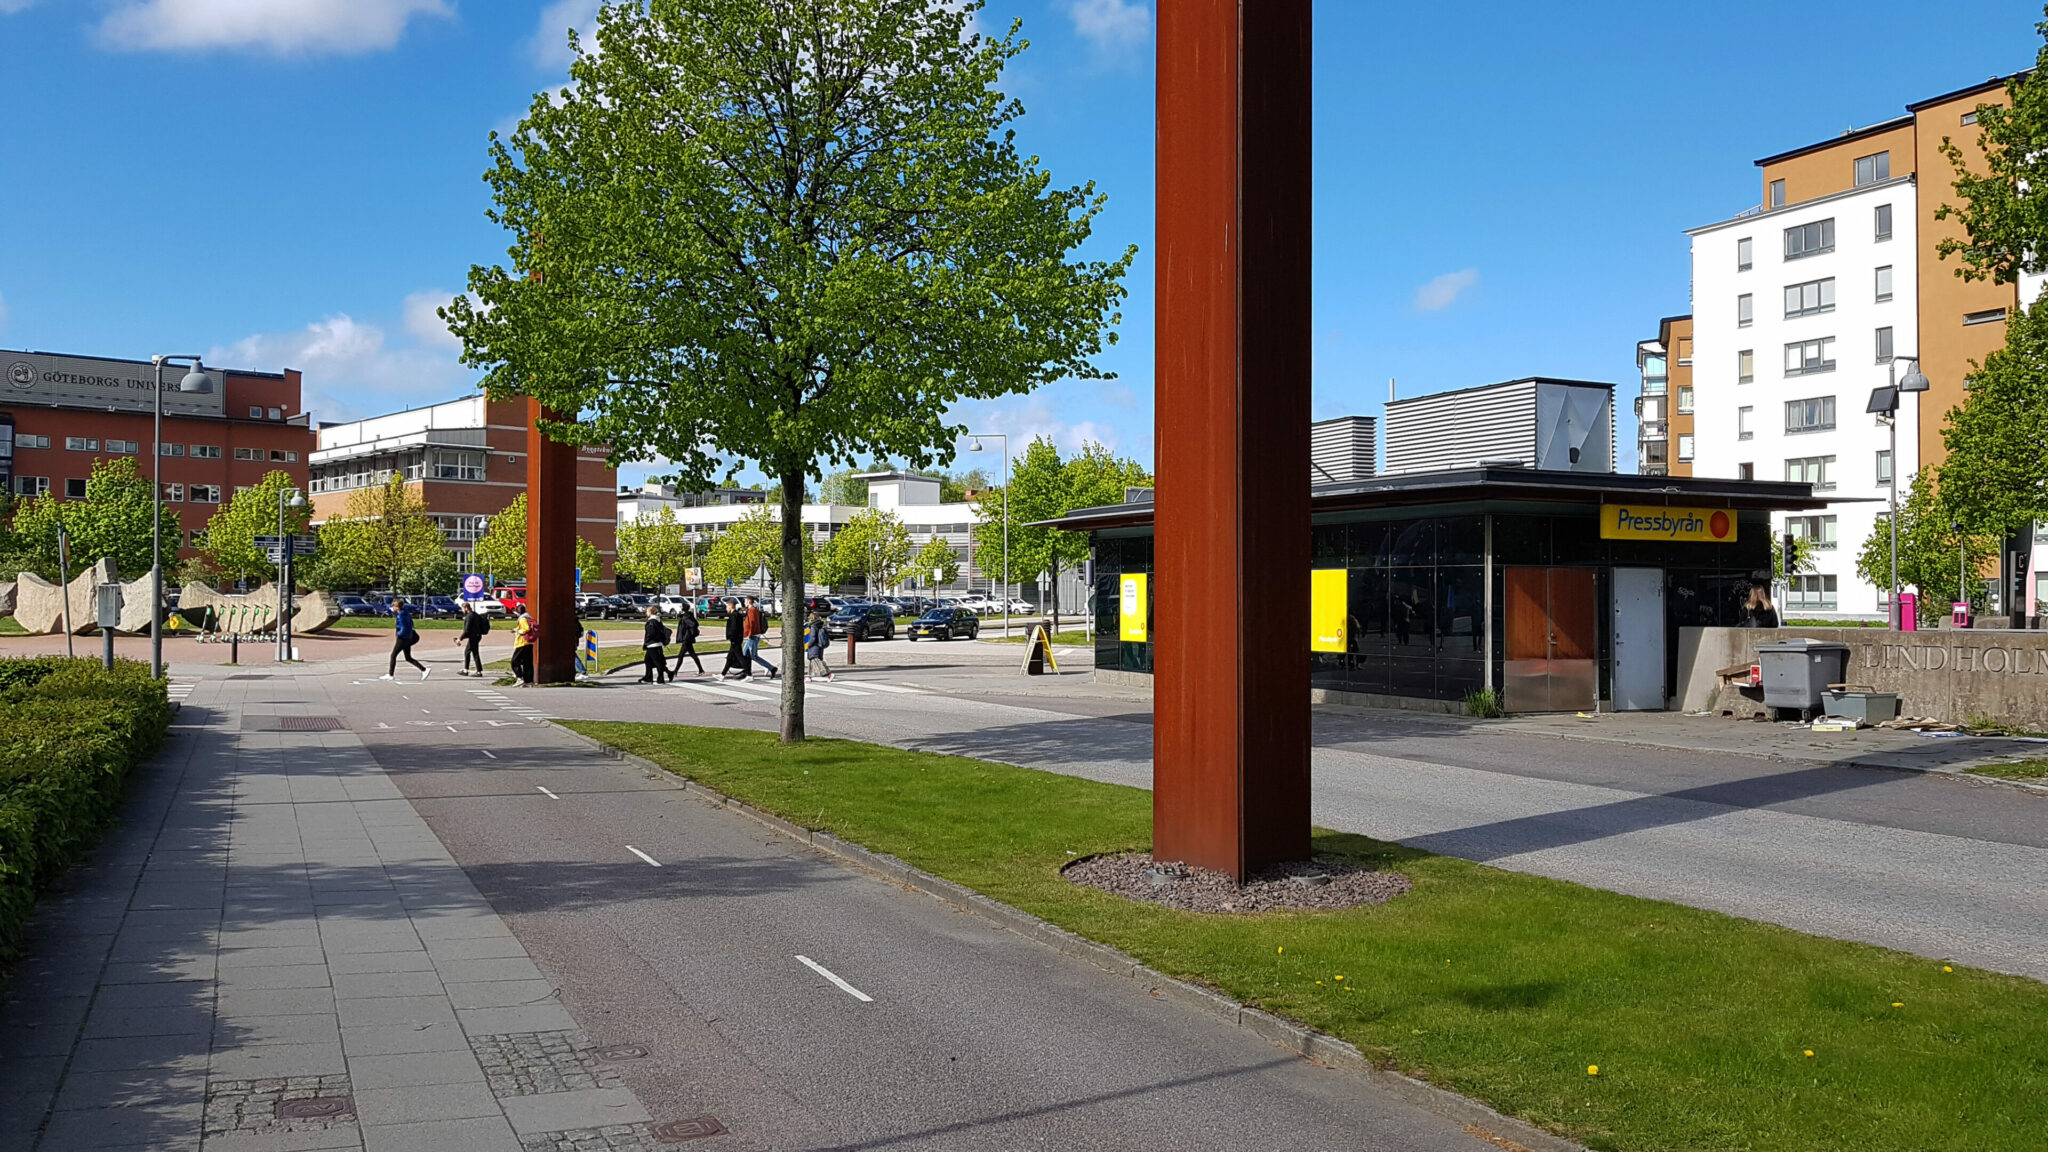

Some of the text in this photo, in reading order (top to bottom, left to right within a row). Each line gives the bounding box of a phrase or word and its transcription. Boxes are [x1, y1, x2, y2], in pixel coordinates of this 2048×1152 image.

[43, 371, 120, 387] GÖTEBORGS
[127, 379, 181, 392] UNIVERS
[1617, 508, 1704, 537] Pressbyrån
